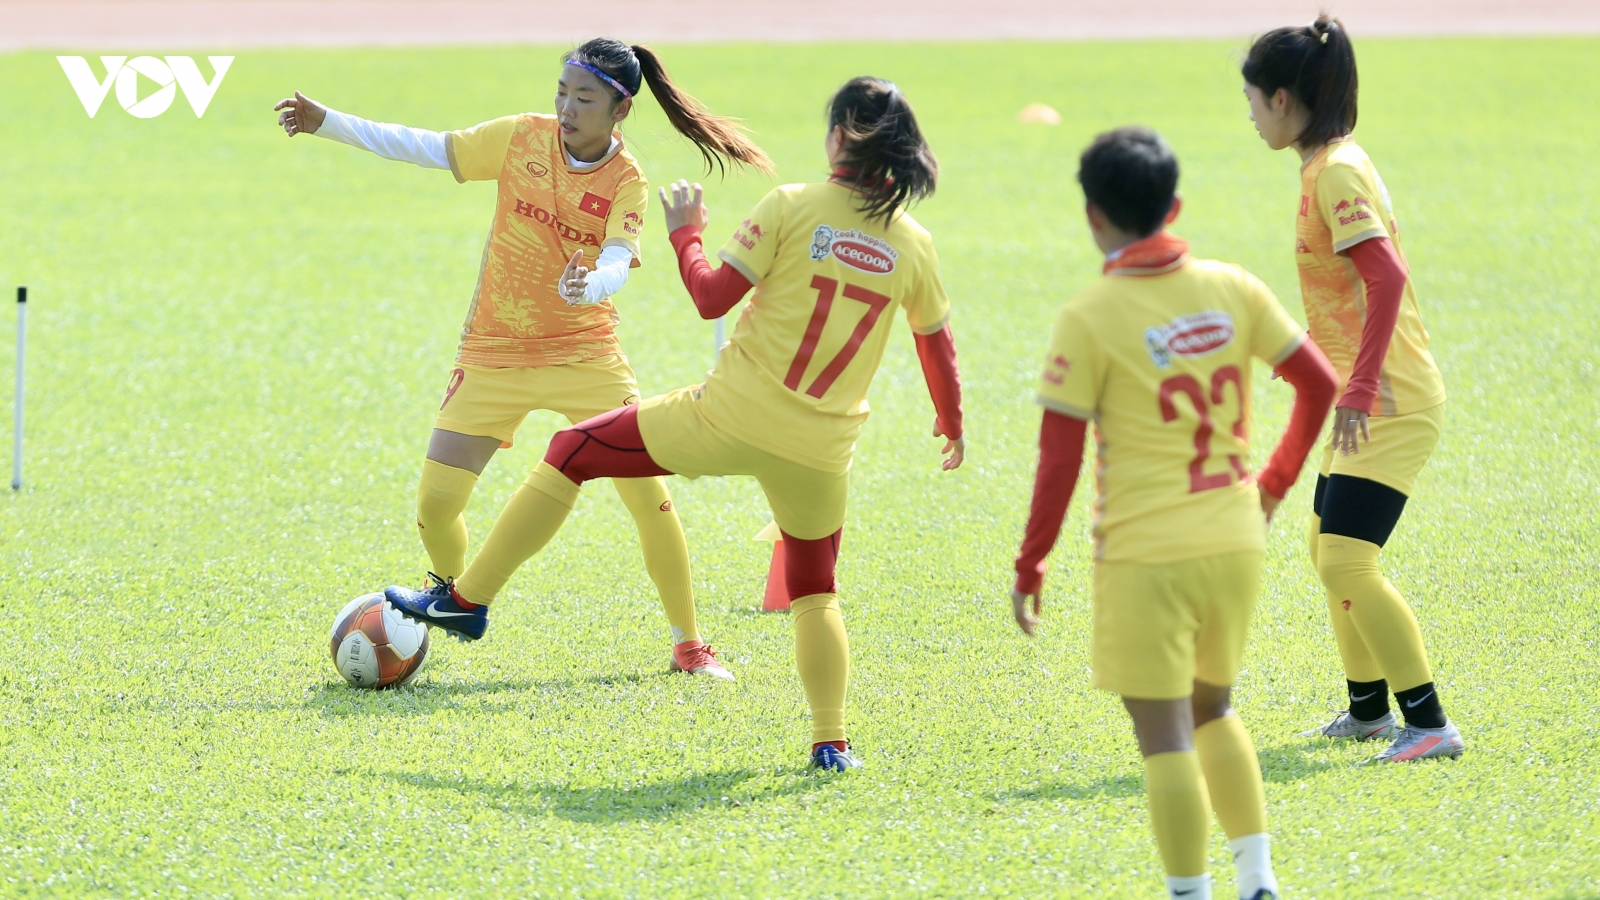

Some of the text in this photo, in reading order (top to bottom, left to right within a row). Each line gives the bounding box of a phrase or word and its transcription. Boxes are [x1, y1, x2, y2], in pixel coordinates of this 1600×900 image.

[514, 198, 600, 247] HONDA
[1338, 210, 1372, 226] Red Bu
[834, 230, 899, 258] Cook happiness
[783, 274, 892, 400] 17
[439, 368, 465, 411] 9
